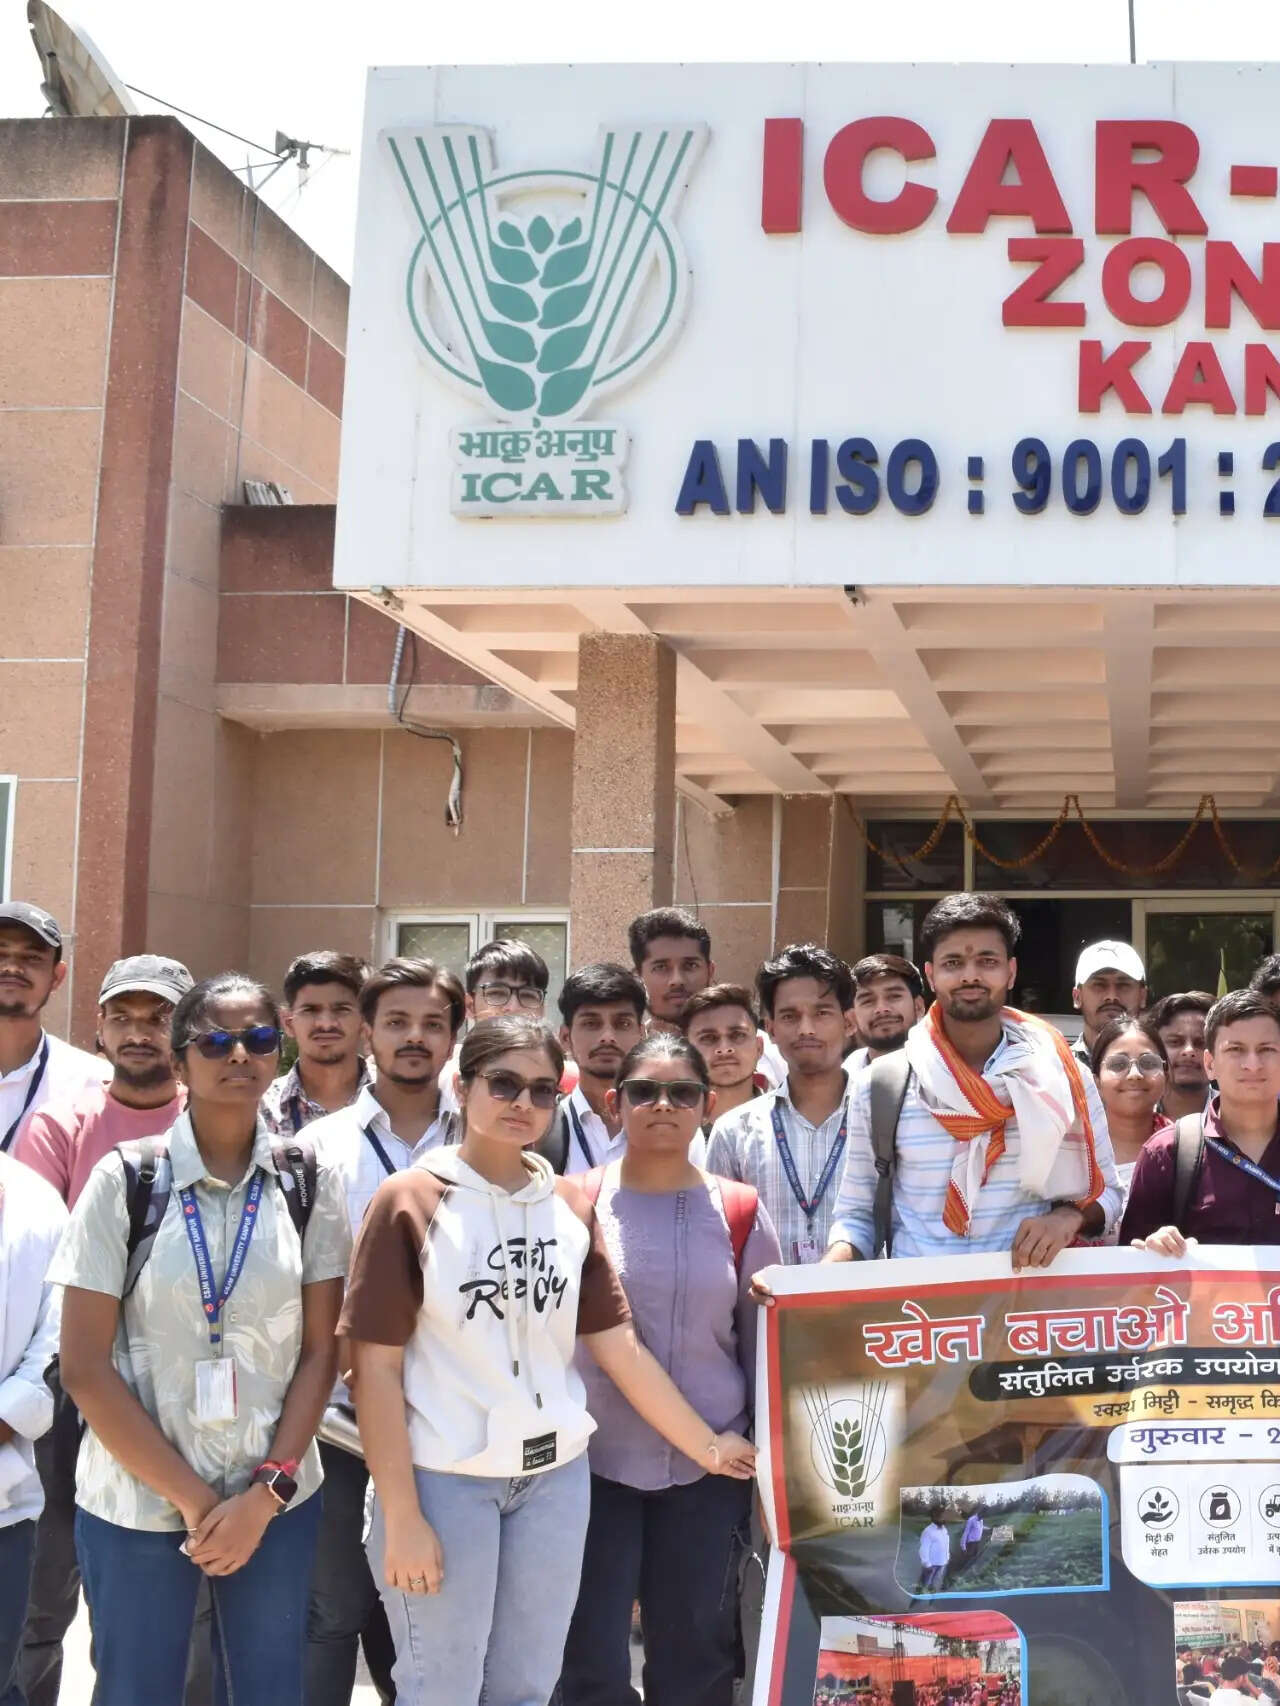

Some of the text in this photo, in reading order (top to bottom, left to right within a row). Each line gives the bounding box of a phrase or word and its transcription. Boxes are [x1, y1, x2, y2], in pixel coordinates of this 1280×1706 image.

[460, 469, 614, 503] ICAR
[676, 438, 788, 512] AN
[809, 437, 939, 512] ISO
[1011, 438, 1186, 512] 9001
[296, 1169, 309, 1207] PROVOGUE
[188, 1218, 201, 1243] KANPUR
[193, 1242, 208, 1281] UNIVERSITY
[458, 1264, 568, 1320] Ready
[863, 1300, 984, 1367] खेत
[1005, 1285, 1190, 1354] बचाओ
[998, 1362, 1095, 1396] संतुलित
[1105, 1356, 1183, 1383] उर्वरक
[1143, 1389, 1180, 1414] मिट्टी
[1129, 1427, 1227, 1454] गुरुवार
[832, 1515, 875, 1529] ICAR
